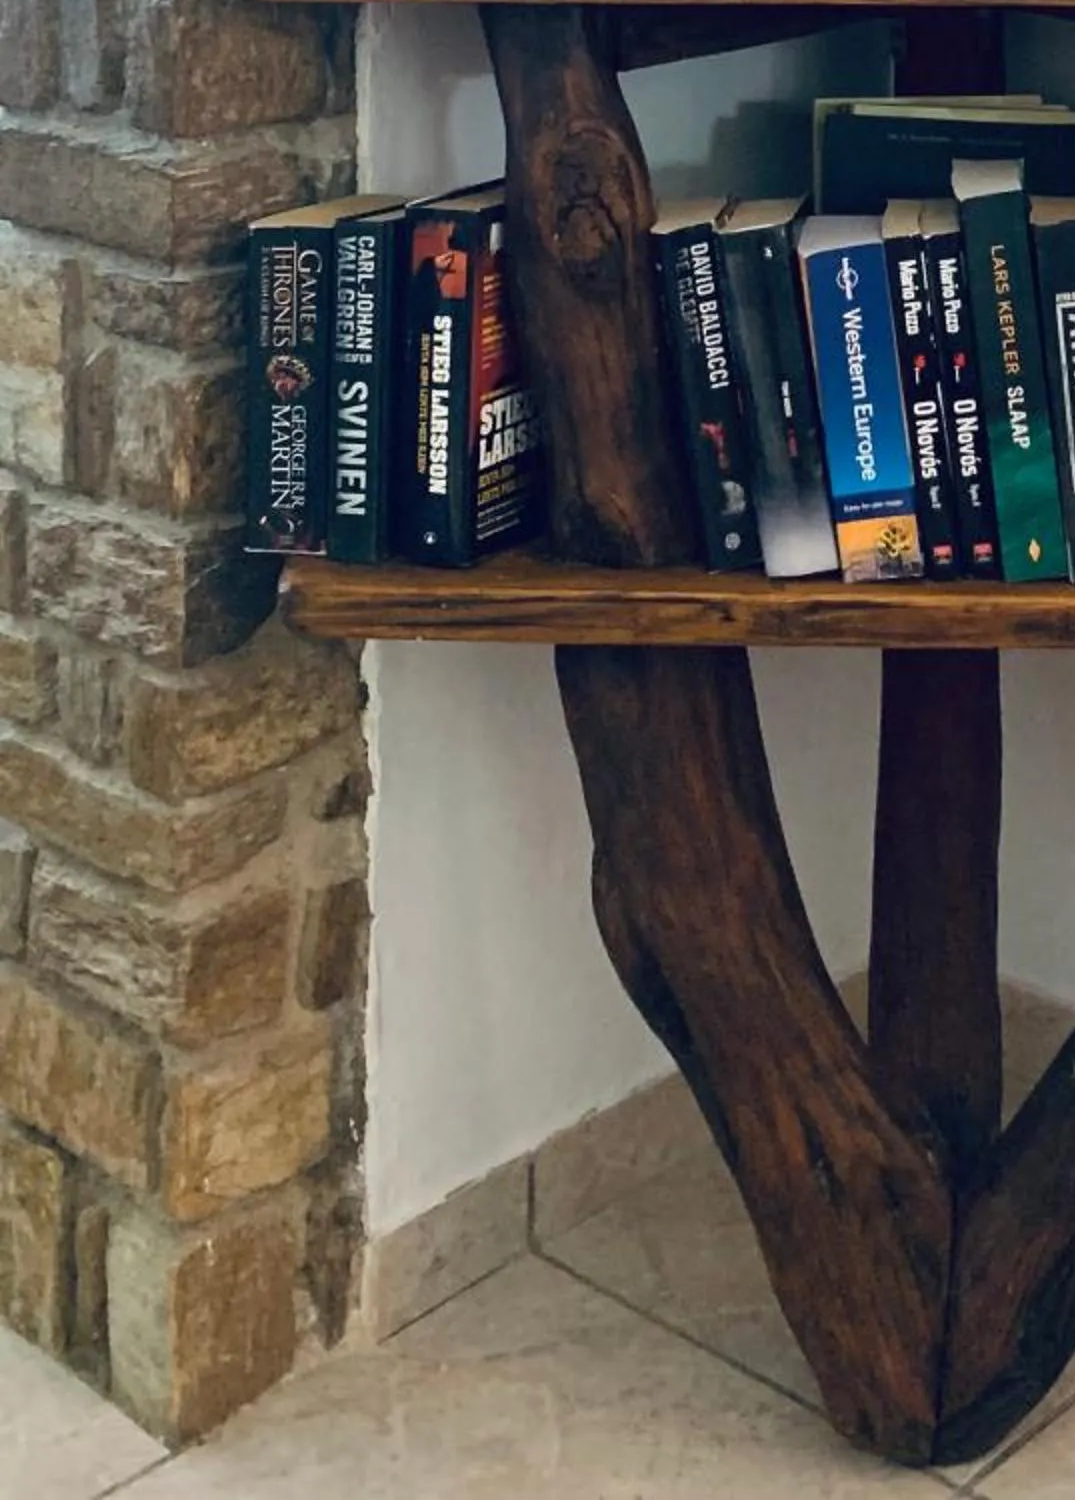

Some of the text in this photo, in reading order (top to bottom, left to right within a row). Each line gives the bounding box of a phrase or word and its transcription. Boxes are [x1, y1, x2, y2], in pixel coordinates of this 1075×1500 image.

[270, 241, 298, 349] THRONES
[297, 248, 323, 324] GAME
[335, 235, 357, 353] VALLGREN
[356, 234, 377, 354] CARL-JOHAN
[689, 242, 730, 390] DAVID BALDACCI
[897, 259, 921, 336] Mario Puzo
[937, 258, 960, 334] Mario Puzo
[428, 314, 452, 496] STIEG LARSSON
[842, 307, 878, 483] Western Europe
[990, 244, 1032, 450] LARS KEPLER SLAAP
[270, 403, 291, 509] MARTIN
[290, 404, 306, 476] GEORGE
[334, 379, 370, 516] SVINEN
